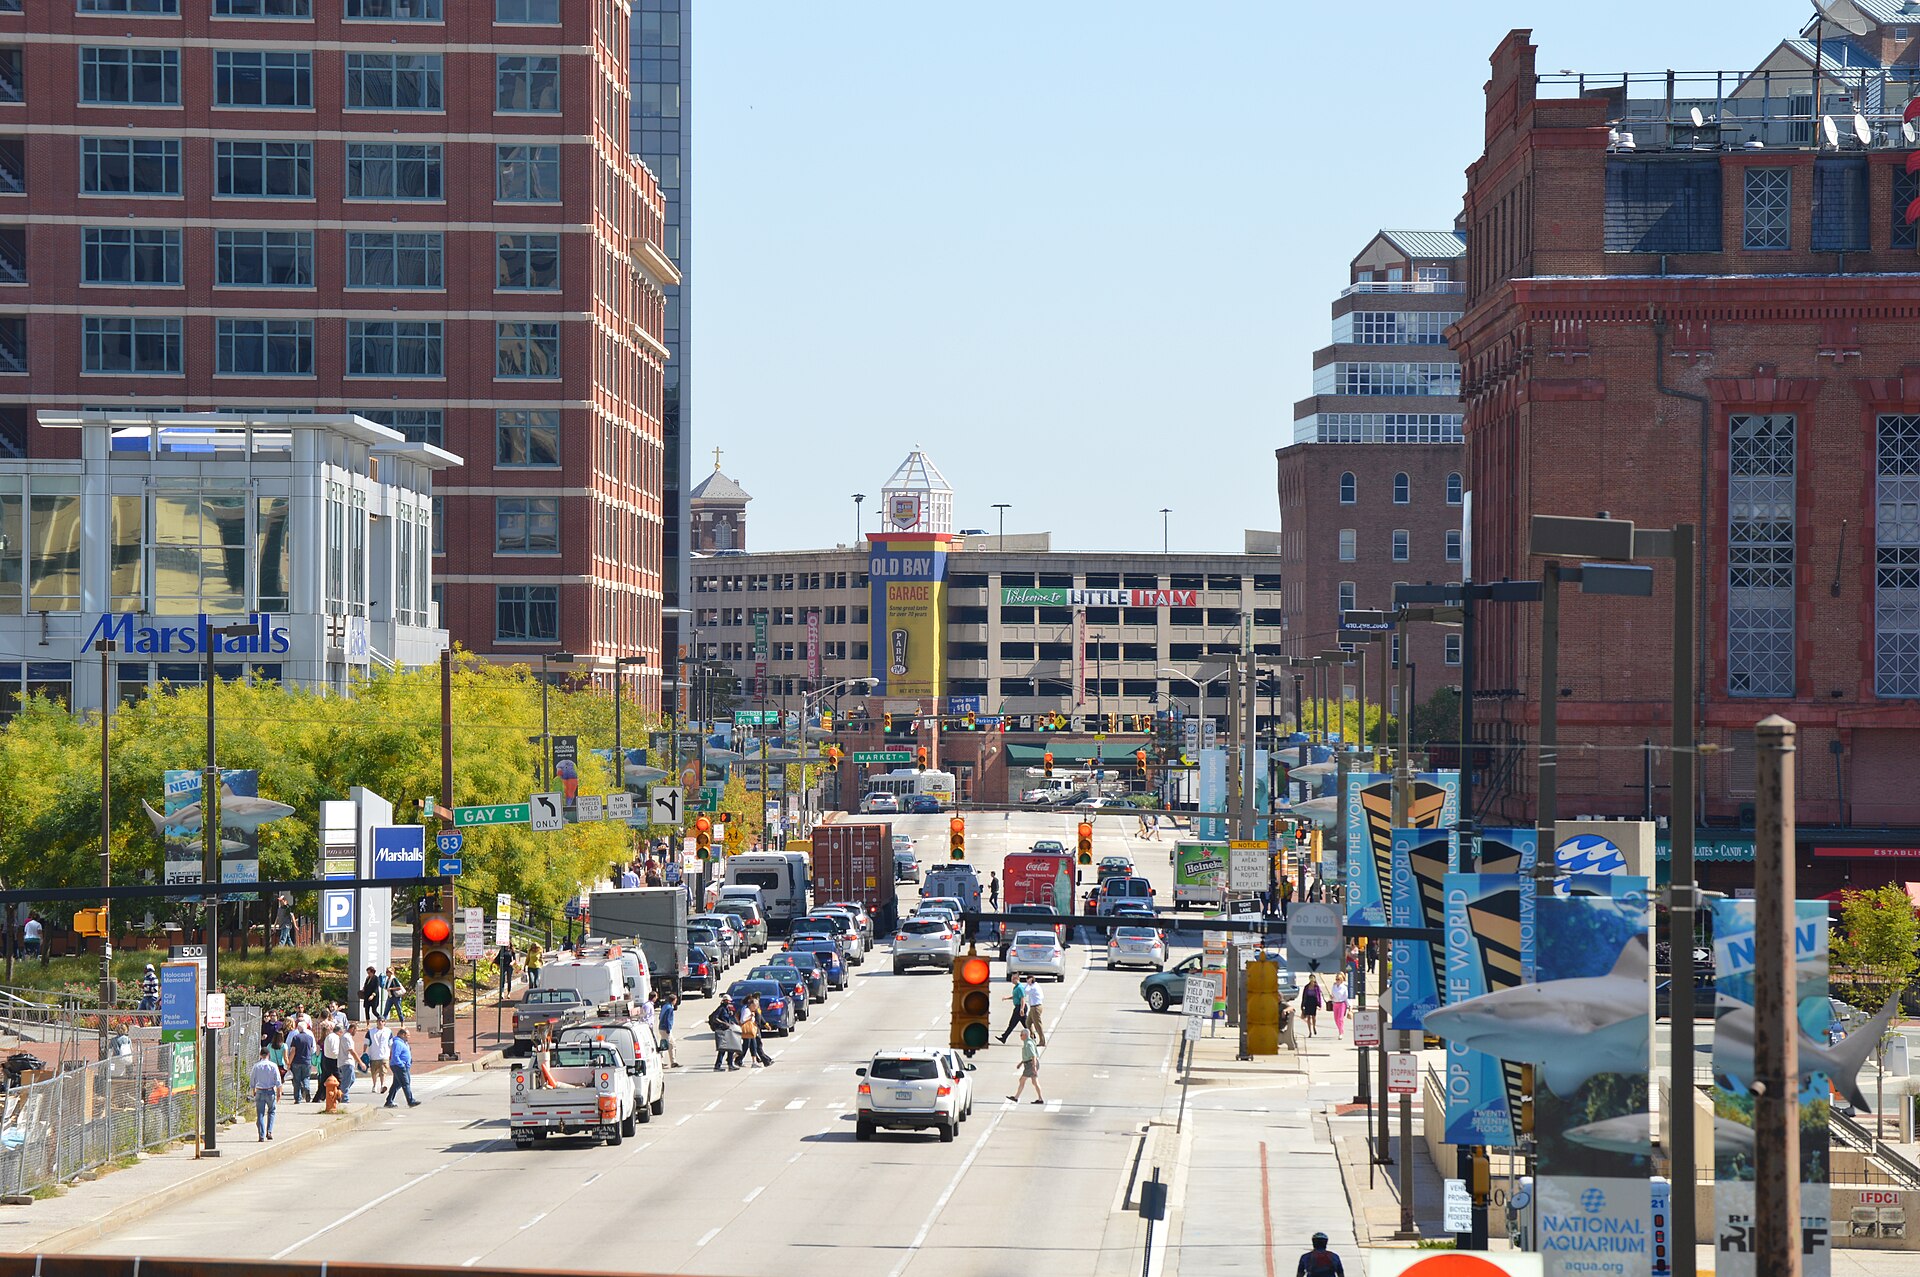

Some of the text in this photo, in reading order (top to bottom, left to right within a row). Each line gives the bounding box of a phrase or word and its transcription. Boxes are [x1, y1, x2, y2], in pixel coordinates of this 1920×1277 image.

[871, 558, 899, 576] OLD
[889, 586, 929, 601] GARAGE
[1006, 588, 1191, 606] Welcome to LITTLE ITALY
[80, 613, 290, 654] Marshalls
[807, 615, 818, 657] Office
[956, 703, 971, 712] $10
[858, 753, 897, 761] MARKET
[169, 778, 199, 793] NEW
[1350, 782, 1361, 829] WORLD
[463, 808, 520, 822] GAY ST
[536, 820, 559, 828] ONLY
[440, 837, 459, 850] 83
[1350, 832, 1361, 855] THE
[375, 847, 423, 862] Marshalls
[1693, 846, 1713, 856] LATES
[1350, 857, 1361, 878] OF
[1395, 840, 1410, 903] WORLD
[167, 875, 202, 884] REEF
[1350, 882, 1361, 906] TOP
[329, 896, 350, 926] P
[1296, 914, 1334, 924] DO NOT
[1449, 889, 1470, 971] WORLD
[1300, 938, 1329, 947] ENTER
[1727, 924, 1816, 968] NW
[182, 946, 203, 957] 500
[1395, 939, 1410, 964] OF
[1202, 980, 1215, 988] TURN
[1395, 969, 1410, 1002] TOP
[1450, 979, 1470, 1002] HE
[1187, 986, 1214, 998] YIELD TO
[1185, 996, 1212, 1005] PEDS AND
[1188, 1005, 1207, 1014] BIKES
[1399, 1058, 1407, 1066] NO
[1390, 1068, 1415, 1076] STOPPING
[1450, 1063, 1470, 1107] TOP
[1471, 1117, 1509, 1125] SEVENTH
[1476, 1125, 1504, 1133] FLOOR
[1448, 1194, 1469, 1202] PROHIB
[1651, 1199, 1665, 1209] 21
[1454, 1221, 1472, 1229] ONLY
[1543, 1215, 1645, 1235] NATIONAL
[1728, 1214, 1827, 1227] BLTIP
[1543, 1235, 1645, 1253] AQUARIUM
[1720, 1225, 1828, 1255] RF
[1565, 1261, 1624, 1275] aqua.org
